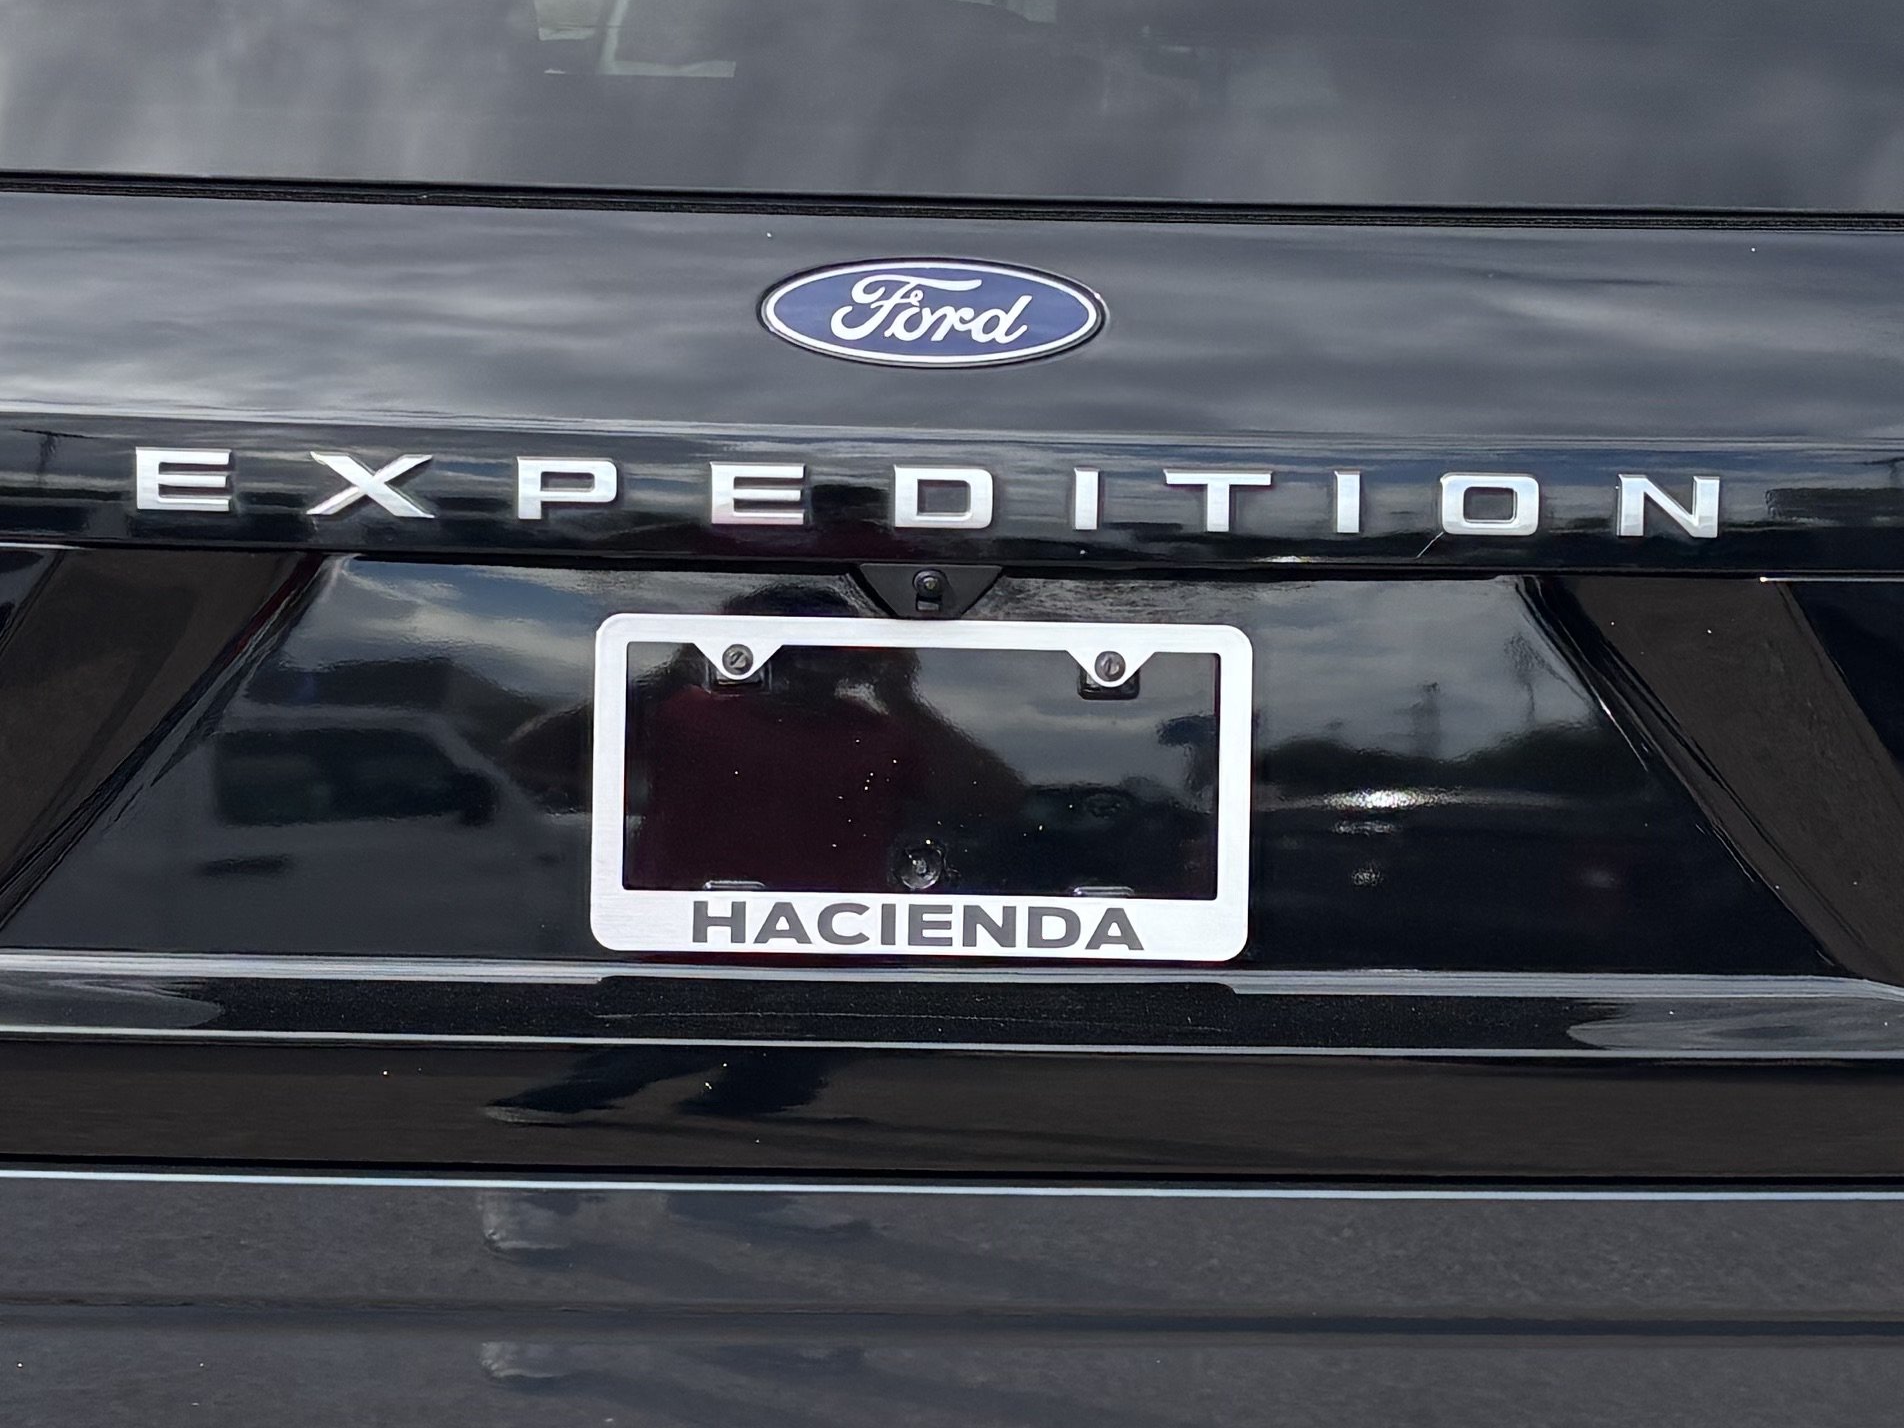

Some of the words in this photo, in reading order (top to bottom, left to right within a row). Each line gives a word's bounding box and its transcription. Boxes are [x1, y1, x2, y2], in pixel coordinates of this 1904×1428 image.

[830, 273, 1033, 345] Ford
[135, 446, 1720, 539] EXPEDITION
[692, 899, 1145, 951] HACIENDA
